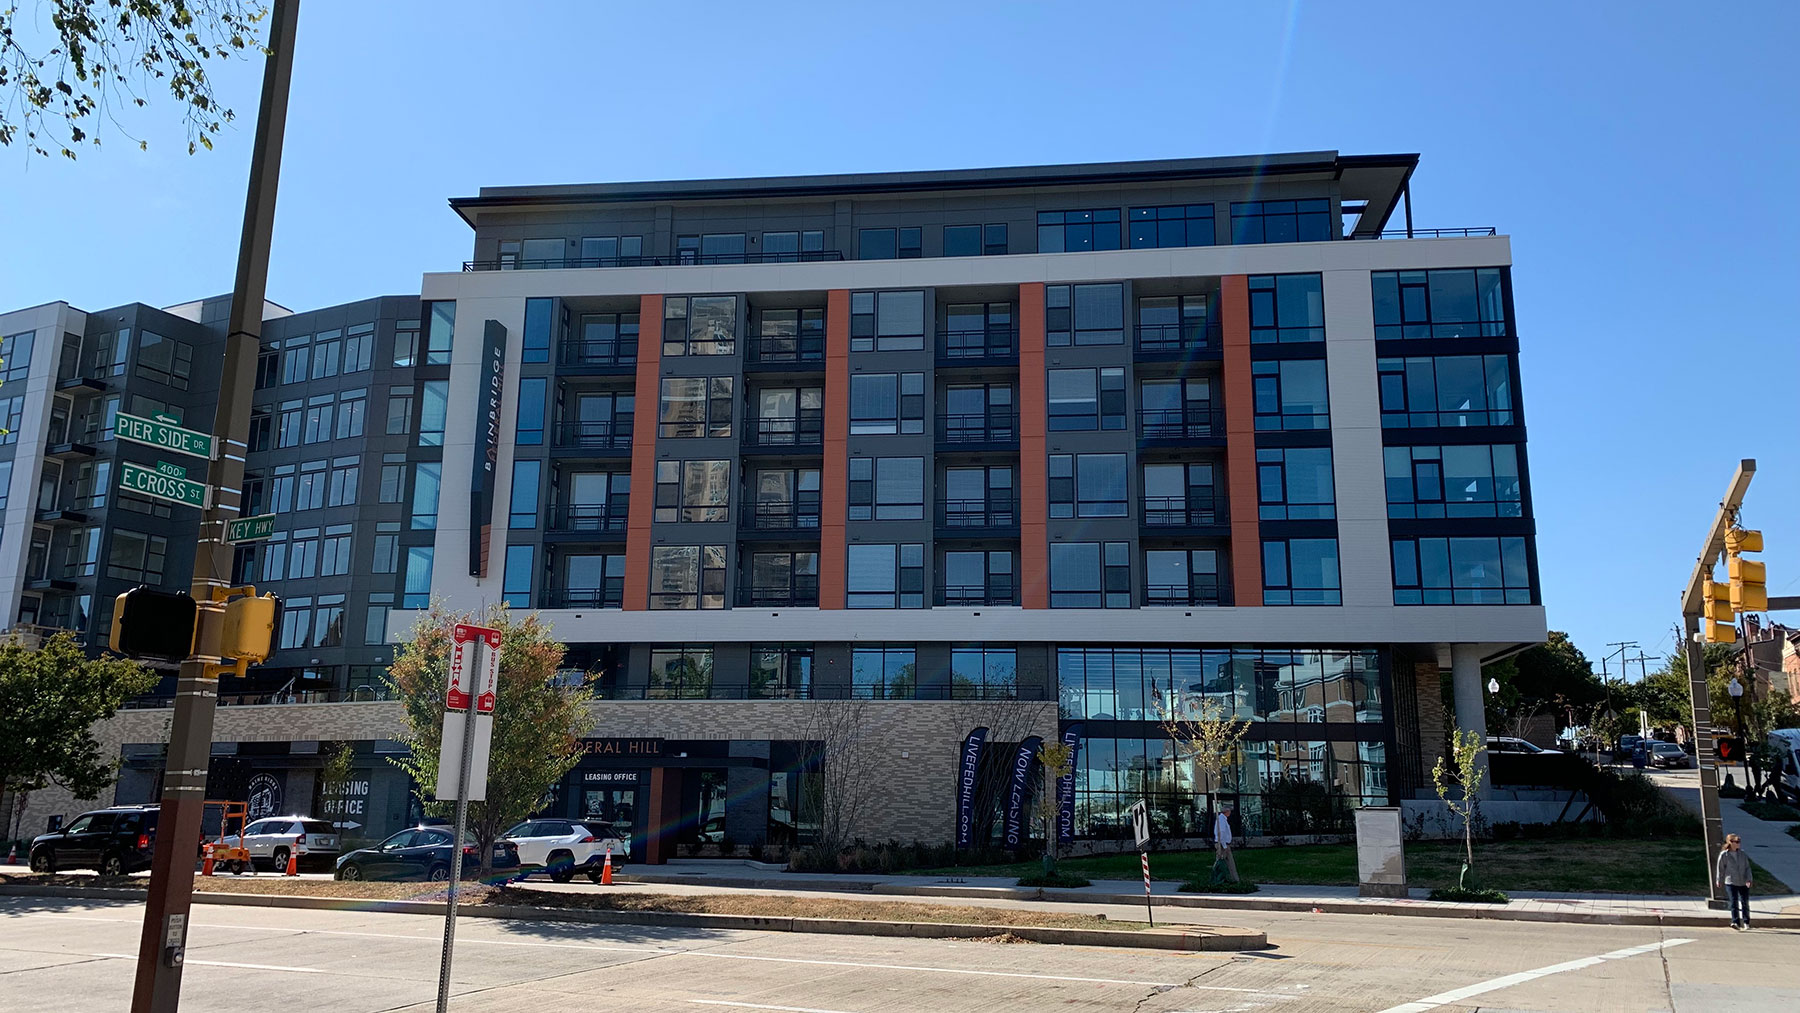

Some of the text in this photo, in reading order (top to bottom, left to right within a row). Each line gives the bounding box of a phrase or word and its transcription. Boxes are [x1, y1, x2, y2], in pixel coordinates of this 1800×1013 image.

[485, 346, 501, 471] BAINBRIDGE
[118, 417, 153, 441] PIER
[158, 428, 191, 451] SIDE
[160, 464, 180, 477] 400
[229, 519, 274, 540] KEY HWY
[568, 741, 660, 754] DERAL HILL
[585, 773, 637, 781] LEASING OFFICE
[961, 736, 981, 843] LIVEFEDHILL.COM
[1007, 747, 1032, 845] NOW LEASING
[324, 800, 363, 815] OFFICE
